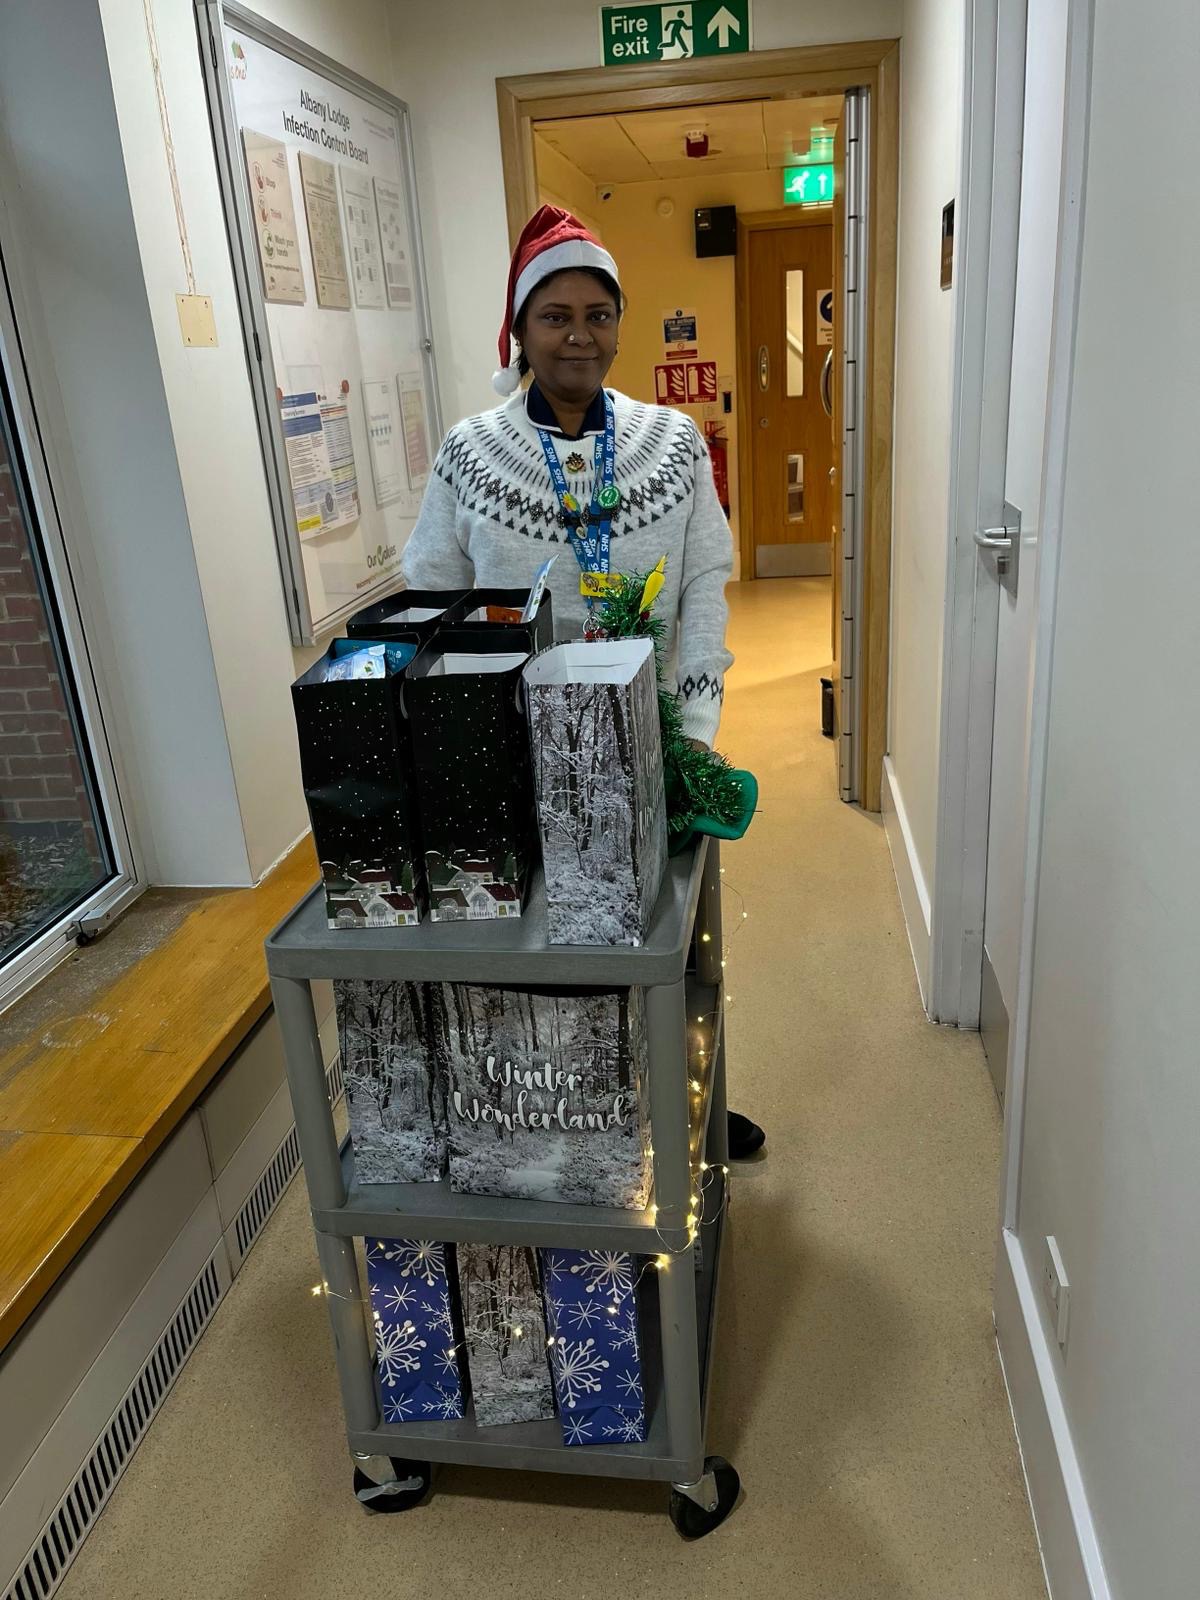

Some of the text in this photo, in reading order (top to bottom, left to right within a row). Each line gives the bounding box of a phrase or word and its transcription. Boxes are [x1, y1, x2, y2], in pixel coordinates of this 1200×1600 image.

[611, 15, 648, 35] Fire
[612, 36, 650, 57] exit
[300, 89, 326, 122] Albany
[327, 103, 350, 132] Lodge
[282, 110, 320, 144] Infection
[320, 128, 348, 156] Control
[348, 140, 369, 165] Board
[606, 415, 614, 430] NHS
[595, 442, 604, 460] NHS
[606, 435, 614, 452] NHS
[546, 446, 558, 464] NHS
[605, 457, 613, 475] NHS
[553, 468, 565, 485] NHS
[582, 540, 595, 558] NHS
[600, 533, 610, 553] NHS
[486, 1055, 583, 1092] Winter
[453, 1089, 631, 1132] Wonderland
